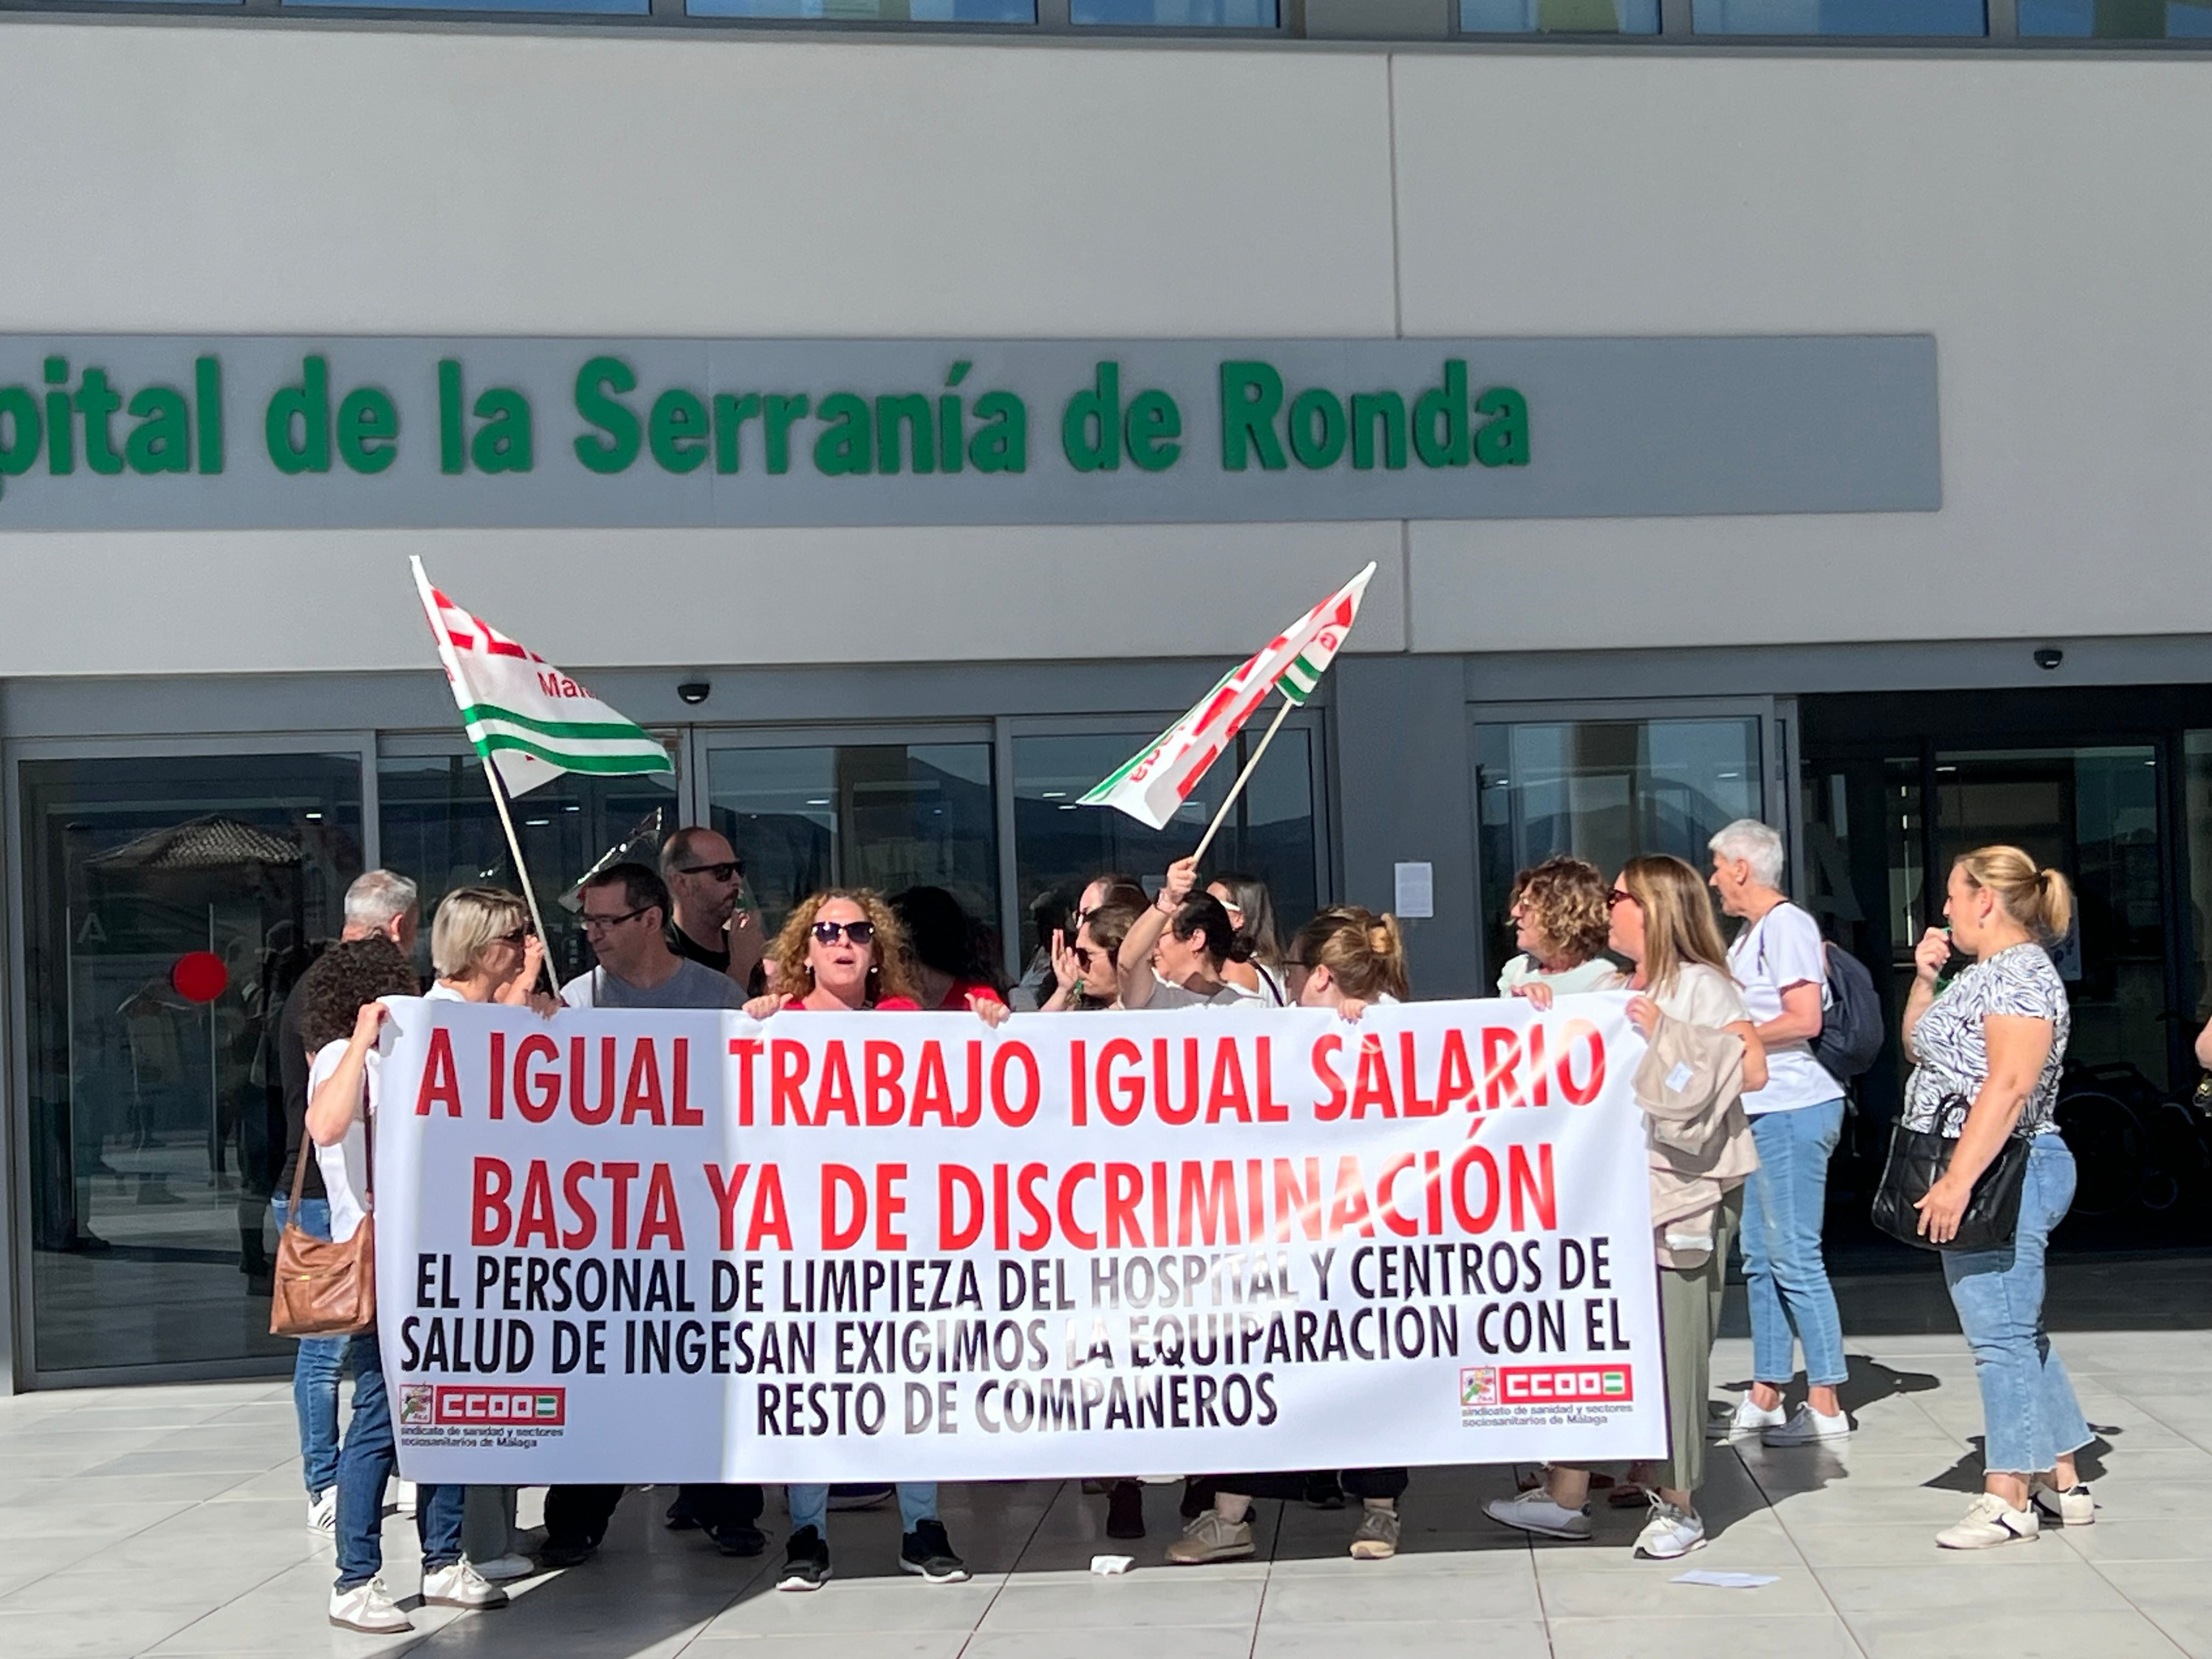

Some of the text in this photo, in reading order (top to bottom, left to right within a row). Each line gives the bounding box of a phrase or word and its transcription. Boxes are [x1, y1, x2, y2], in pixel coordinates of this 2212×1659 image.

[265, 356, 397, 475] de
[438, 359, 533, 475] la
[574, 356, 1028, 477] Serranía
[1062, 360, 1182, 472] de
[1221, 359, 1531, 471] Ronda
[415, 1018, 1606, 1128] A IGUAL TRABAJO IGUAL SALARIO
[471, 1117, 1558, 1253] BASTA YA DE DISCRIMINACIÓN
[416, 1236, 1612, 1312] EL PERSONAL DE LIMPIEZA DEL HOSPITAL Y CENTROS DE
[401, 1316, 534, 1374] SALUD
[552, 1319, 607, 1374] DE
[624, 1319, 815, 1375] INGESAN
[836, 1318, 1049, 1374] EXIGIMOS
[1066, 1316, 1115, 1370] LA
[1477, 1300, 1568, 1355] CON
[1585, 1298, 1630, 1351] EL
[1506, 1372, 1601, 1397] CCOO
[443, 1393, 533, 1418] CCOO
[757, 1382, 886, 1437] RESTO
[904, 1381, 958, 1435] DE
[1462, 1406, 1511, 1417] sindicato
[1514, 1406, 1528, 1415] de
[1531, 1404, 1573, 1414] sanidad
[1585, 1403, 1633, 1413] sectores
[1462, 1417, 1546, 1427] sociosanitarios
[1549, 1415, 1563, 1425] de
[401, 1437, 477, 1447] sociosanitarios
[480, 1438, 493, 1447] de
[402, 1427, 444, 1436] sindicato
[447, 1427, 460, 1436] de
[464, 1427, 504, 1436] sanidad
[516, 1428, 563, 1437] sectores
